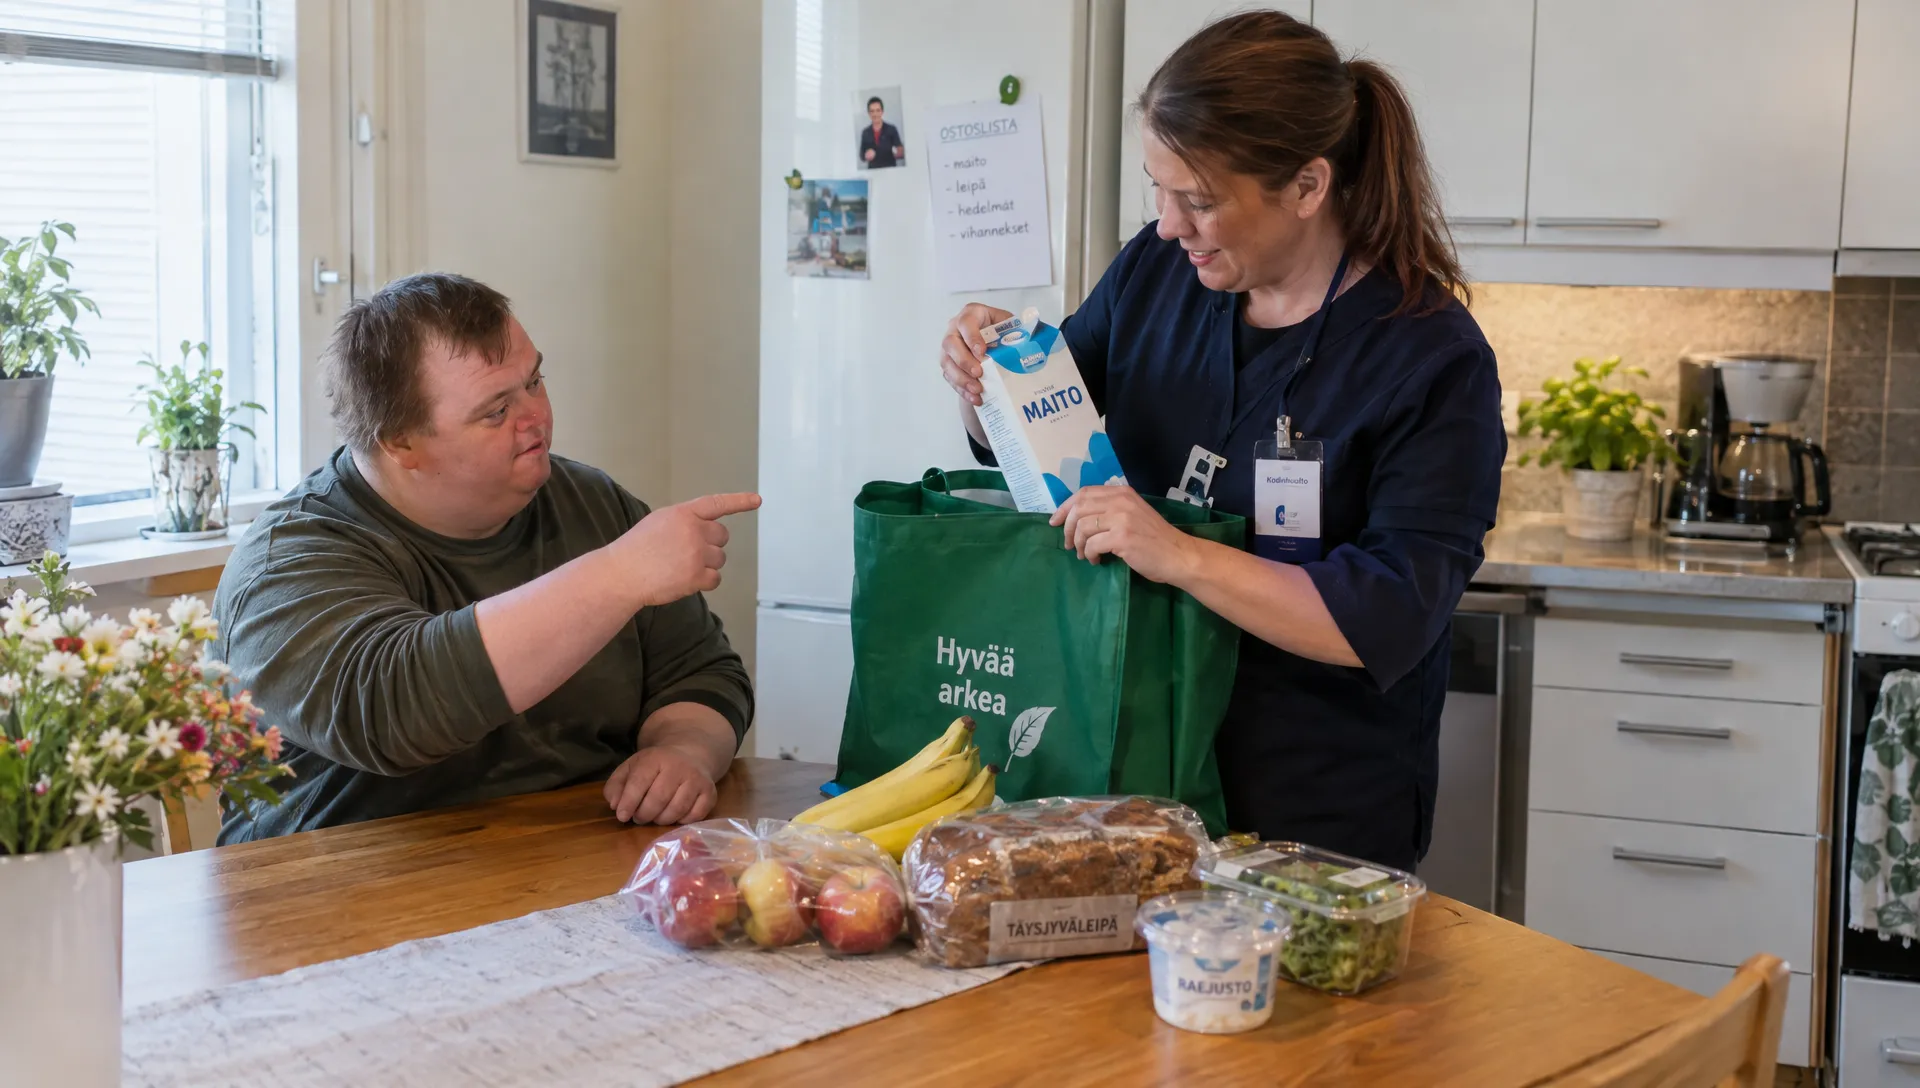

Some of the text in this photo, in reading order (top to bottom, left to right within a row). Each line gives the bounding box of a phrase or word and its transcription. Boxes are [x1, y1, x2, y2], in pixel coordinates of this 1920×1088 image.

[940, 118, 1018, 140] OSTOSLISTA
[953, 156, 987, 169] maito
[956, 178, 986, 196] leipä
[960, 221, 1029, 239] vihannekset
[1022, 386, 1083, 423] MAITO
[936, 636, 1015, 677] Hyvää
[938, 679, 1006, 716] arkea
[1006, 914, 1118, 938] TÄYSJYVÄLEIPÄ
[1178, 977, 1253, 996] RAEJUSTO
